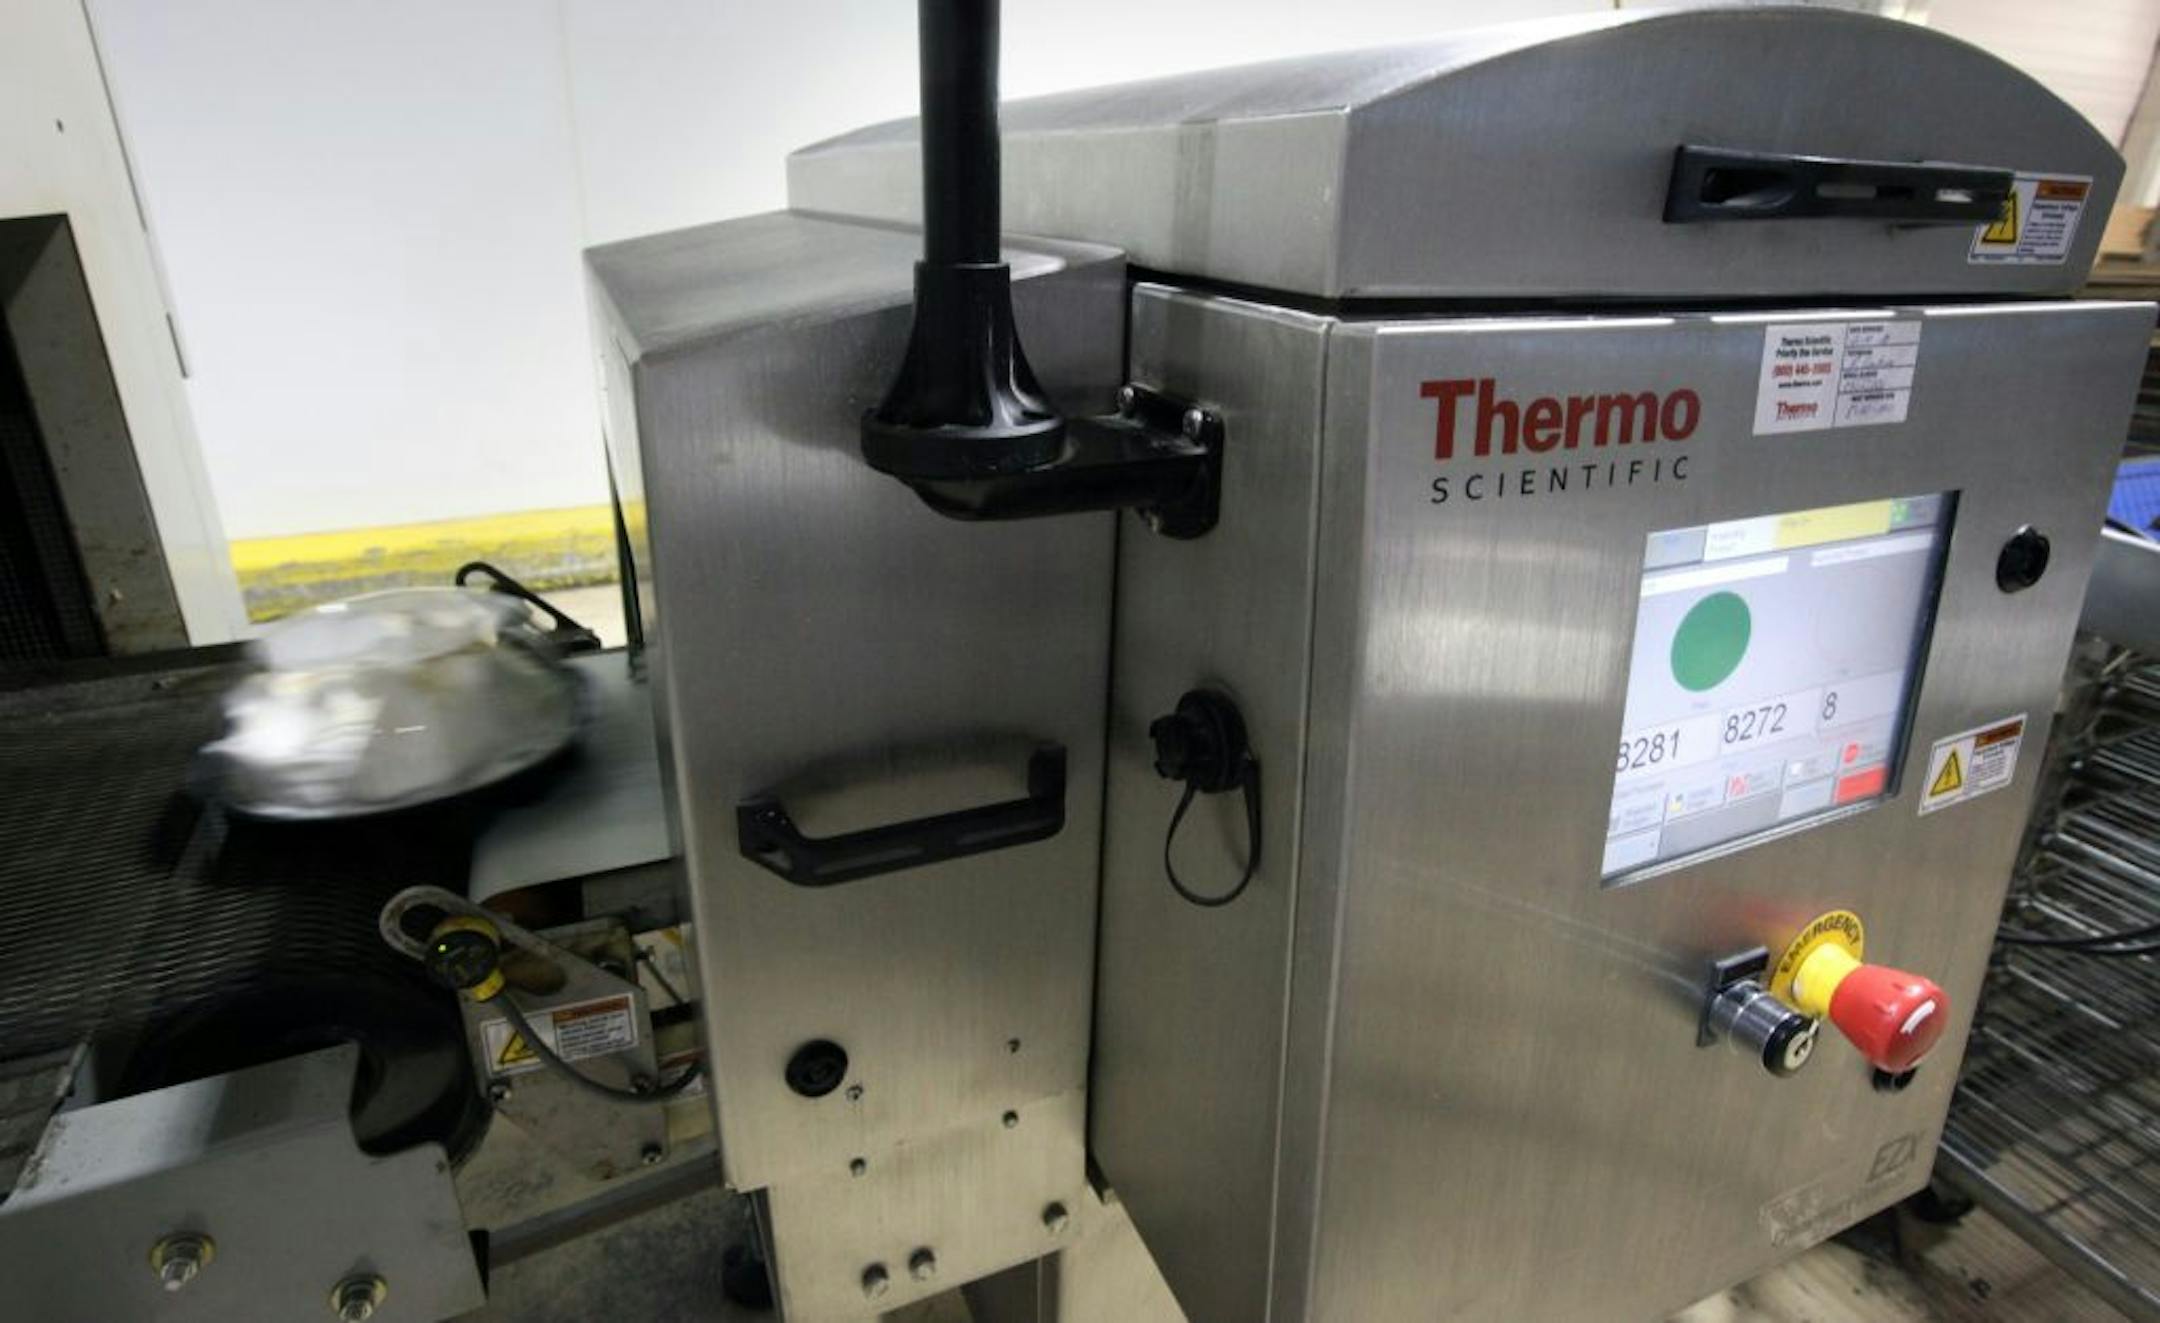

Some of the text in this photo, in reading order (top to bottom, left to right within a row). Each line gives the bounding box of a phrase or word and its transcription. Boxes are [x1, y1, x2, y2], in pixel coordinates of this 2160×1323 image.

[1421, 378, 1701, 459] Thermo
[1431, 456, 1689, 504] SCIENTIFIC
[1724, 703, 1787, 744] 8272
[1822, 691, 1838, 721] 8
[1615, 729, 1680, 772] 8281
[1780, 913, 1860, 973] EMERGENCY
